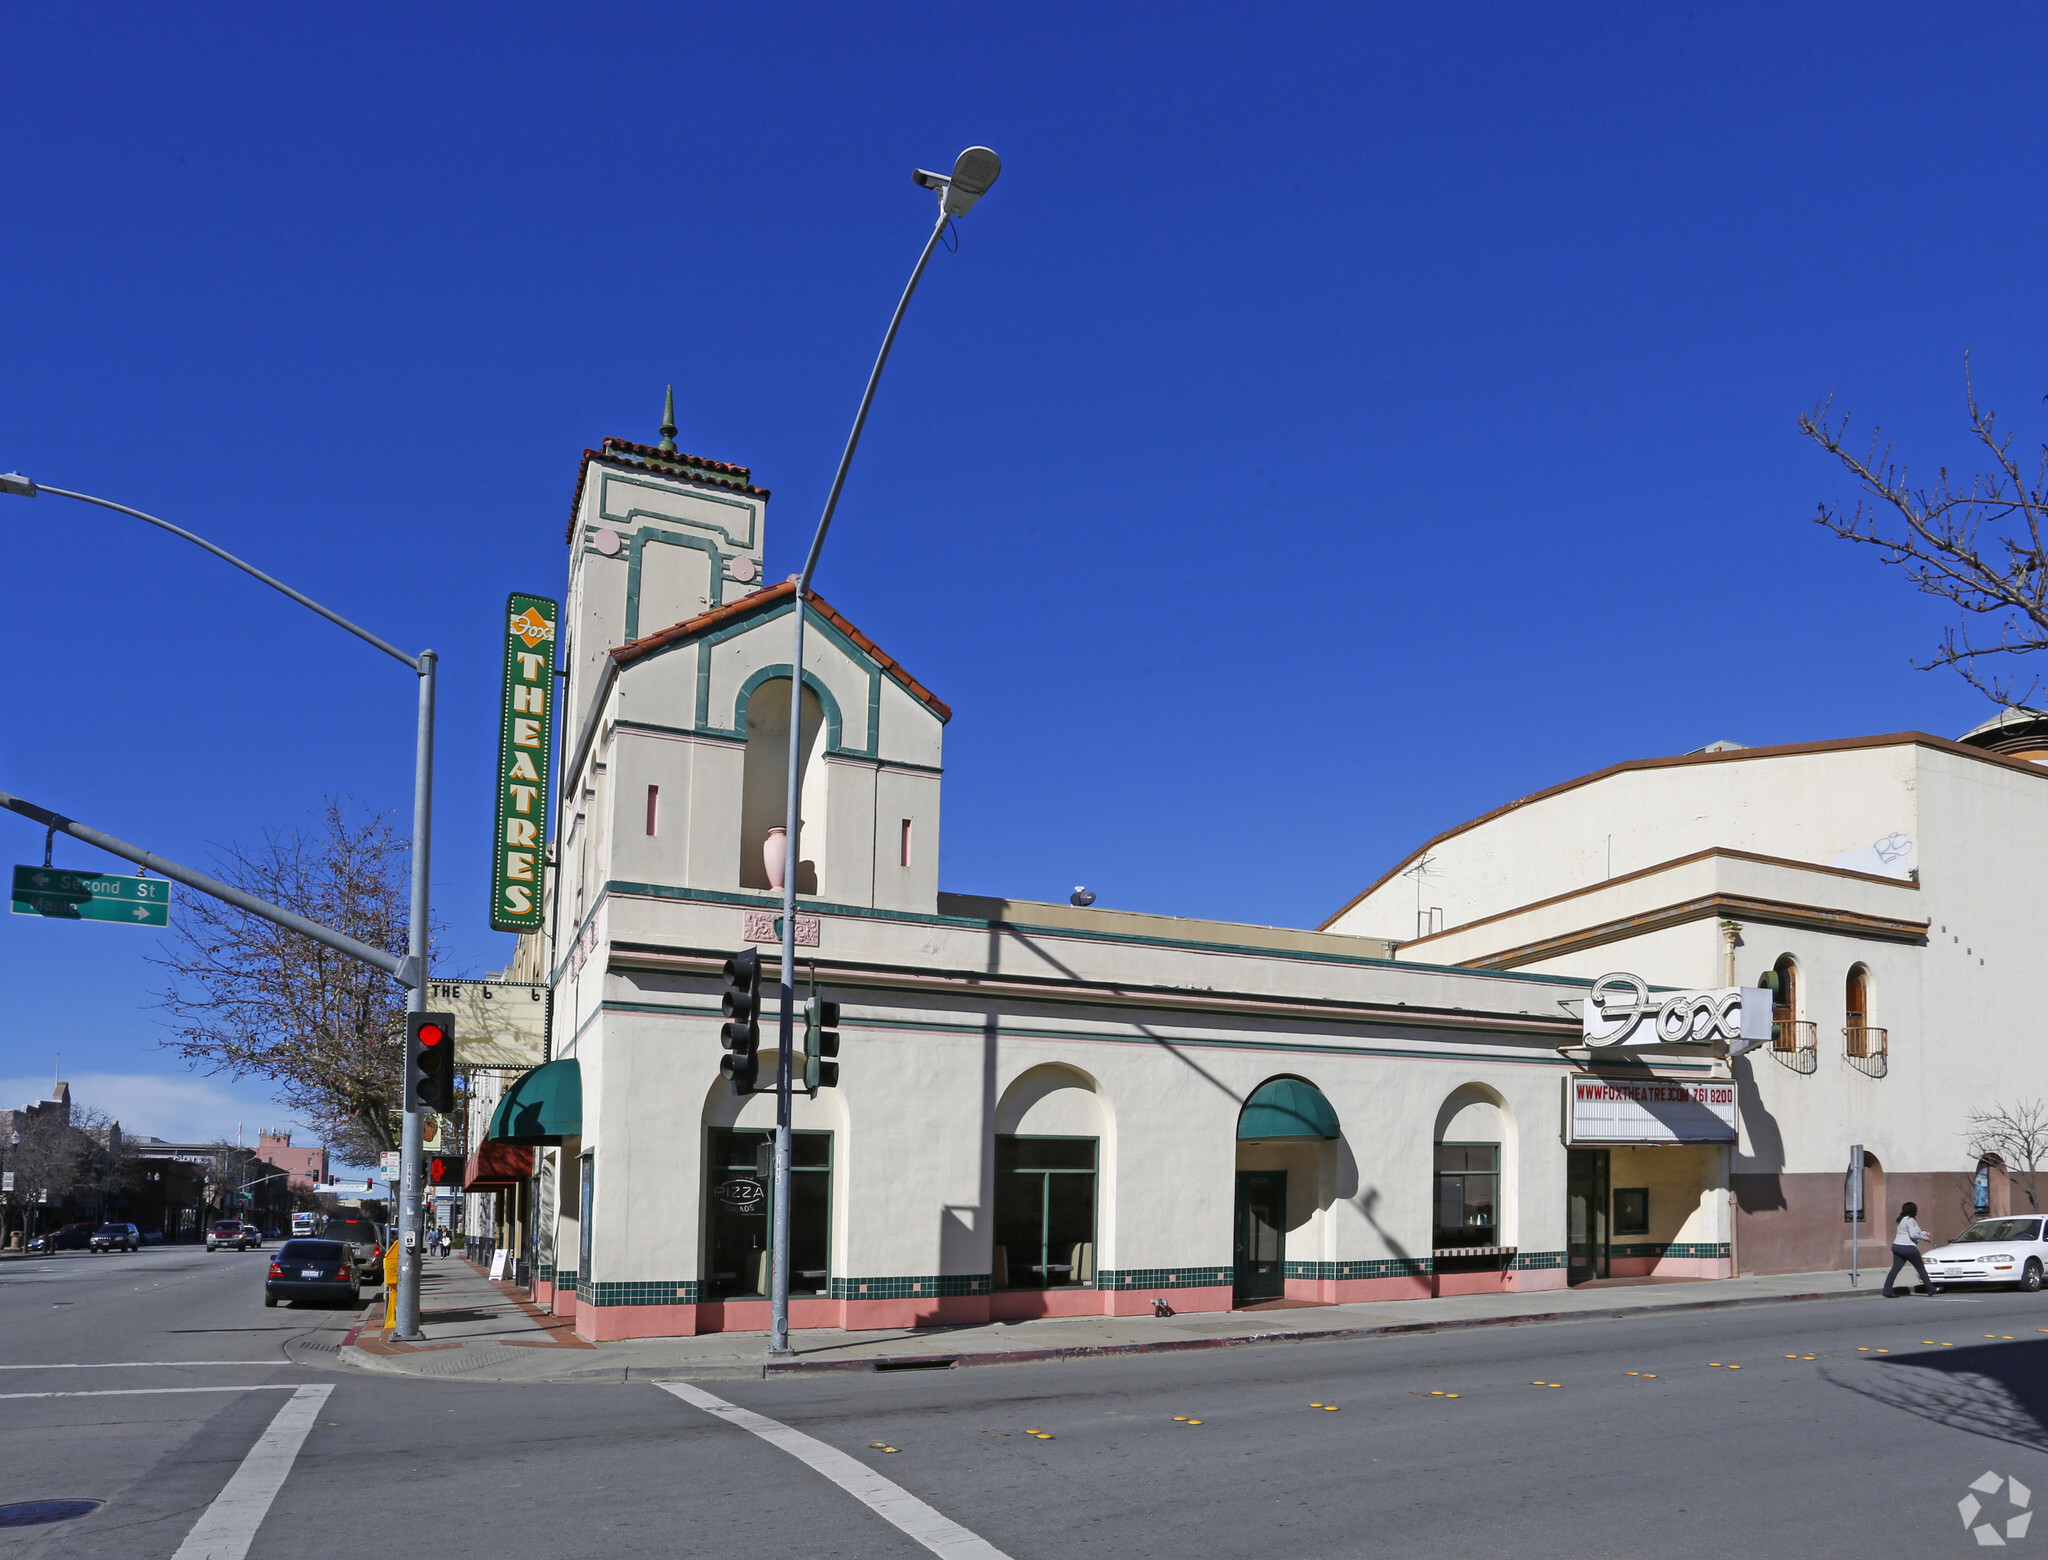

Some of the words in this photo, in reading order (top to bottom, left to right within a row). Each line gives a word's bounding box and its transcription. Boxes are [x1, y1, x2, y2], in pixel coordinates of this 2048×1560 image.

[514, 615, 550, 639] Fox
[504, 651, 545, 915] THEATRES
[60, 875, 120, 894] Second
[136, 883, 156, 898] St
[29, 897, 78, 914] Maple
[432, 985, 460, 998] THE
[1584, 972, 1742, 1047] Fox
[1693, 1089, 1708, 1103] 761
[1710, 1089, 1733, 1103] 8200
[714, 1186, 765, 1198] PIZZA
